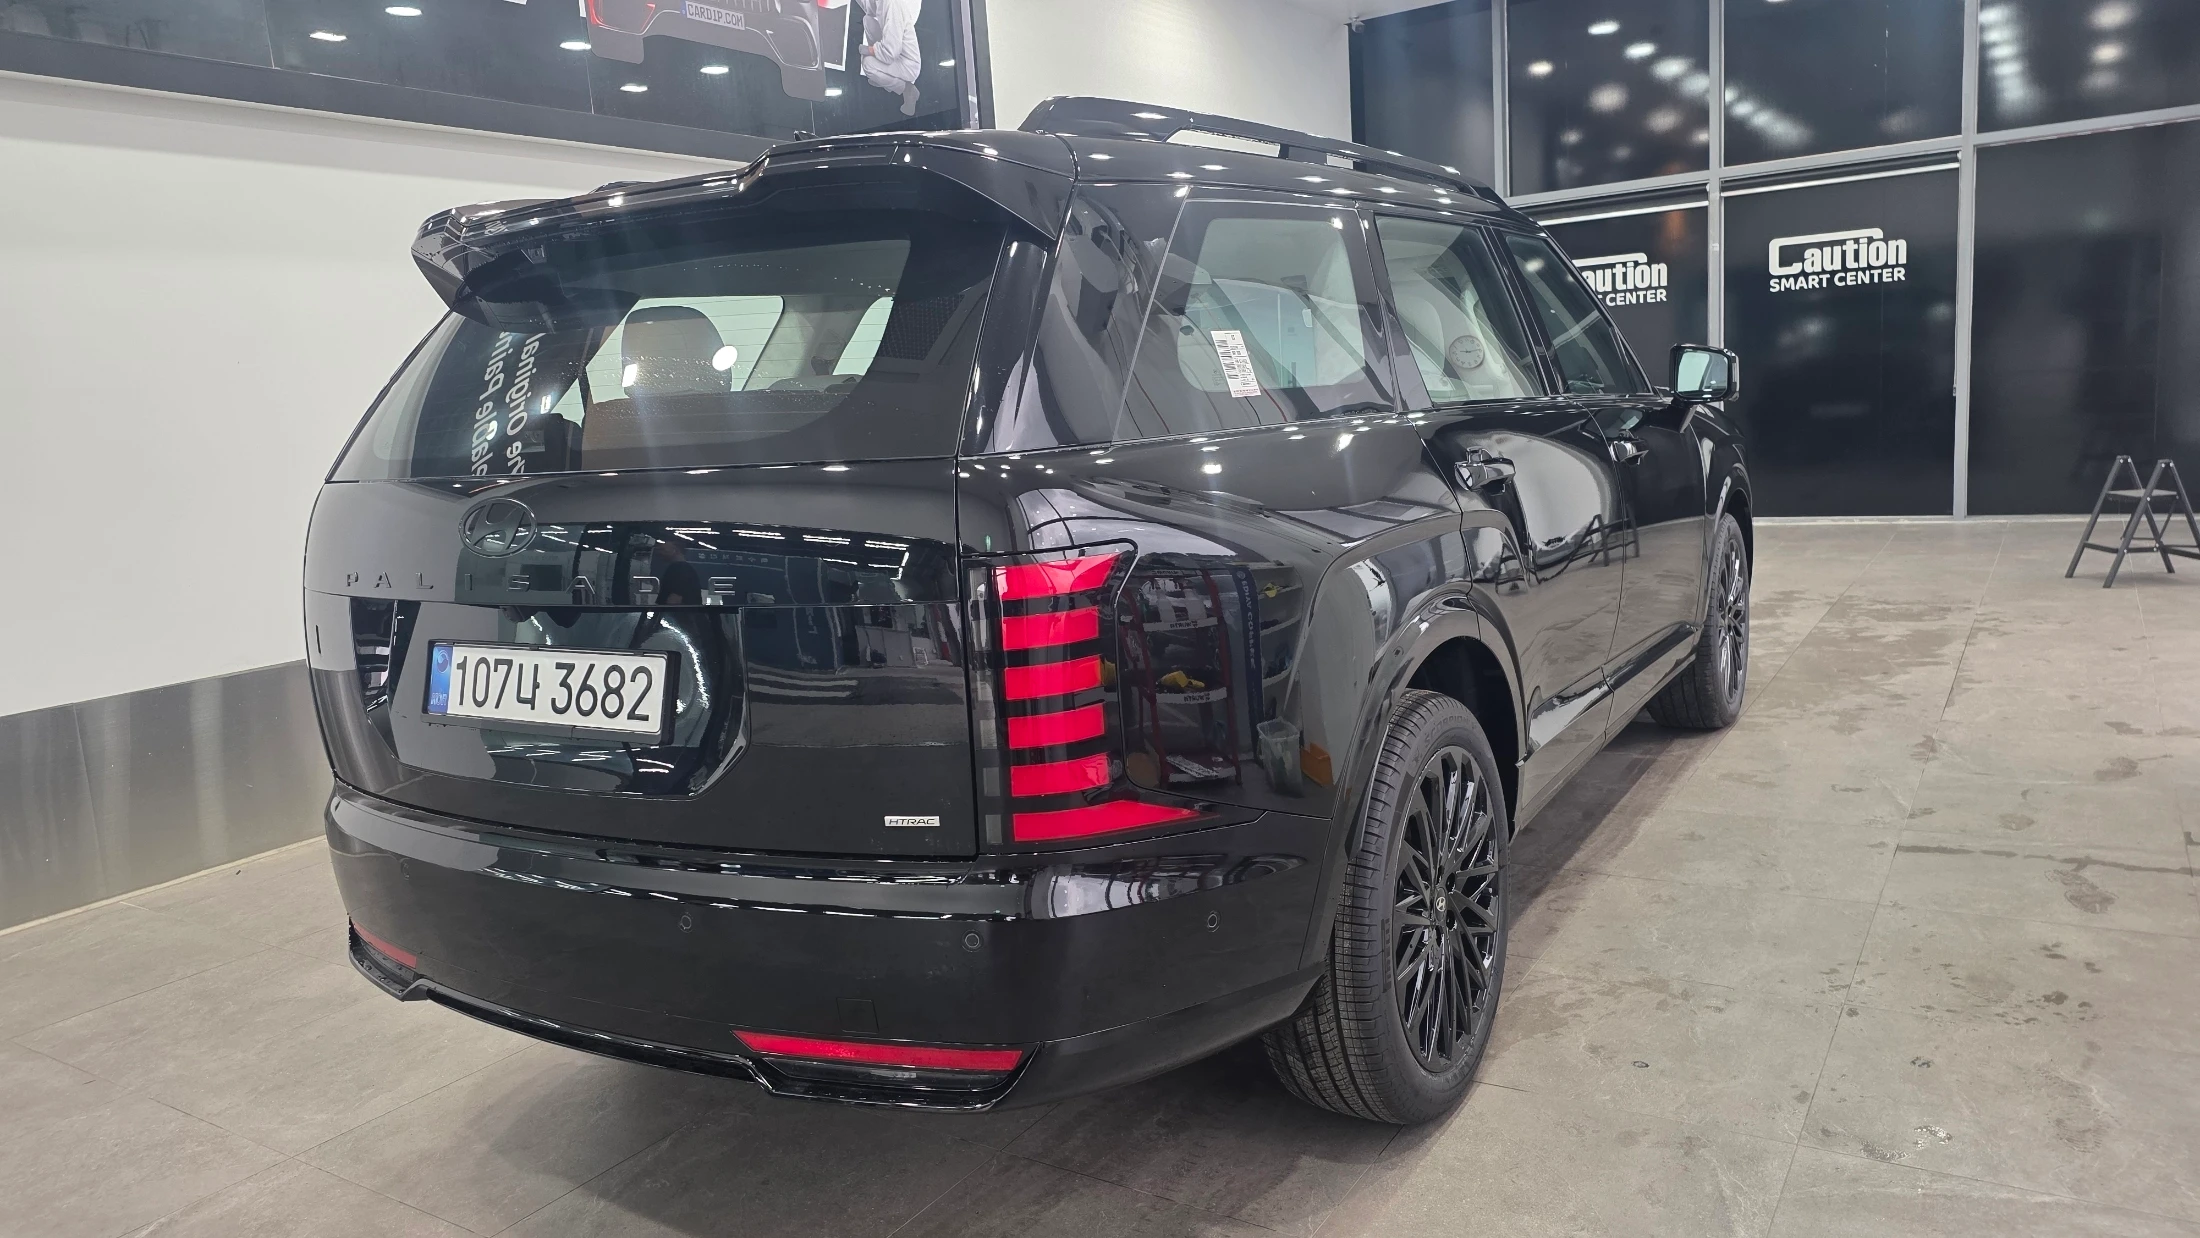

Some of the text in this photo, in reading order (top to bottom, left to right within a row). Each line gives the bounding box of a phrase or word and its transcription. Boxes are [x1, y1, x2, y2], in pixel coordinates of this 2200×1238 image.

[687, 4, 743, 28] CARDIP.COM
[1769, 228, 1907, 276] Caution
[1769, 267, 1906, 293] SMART CENTER
[1605, 289, 1667, 307] CENTER
[345, 571, 738, 596] PALISADE
[550, 661, 653, 721] 3682
[888, 818, 935, 826] HTRAC
